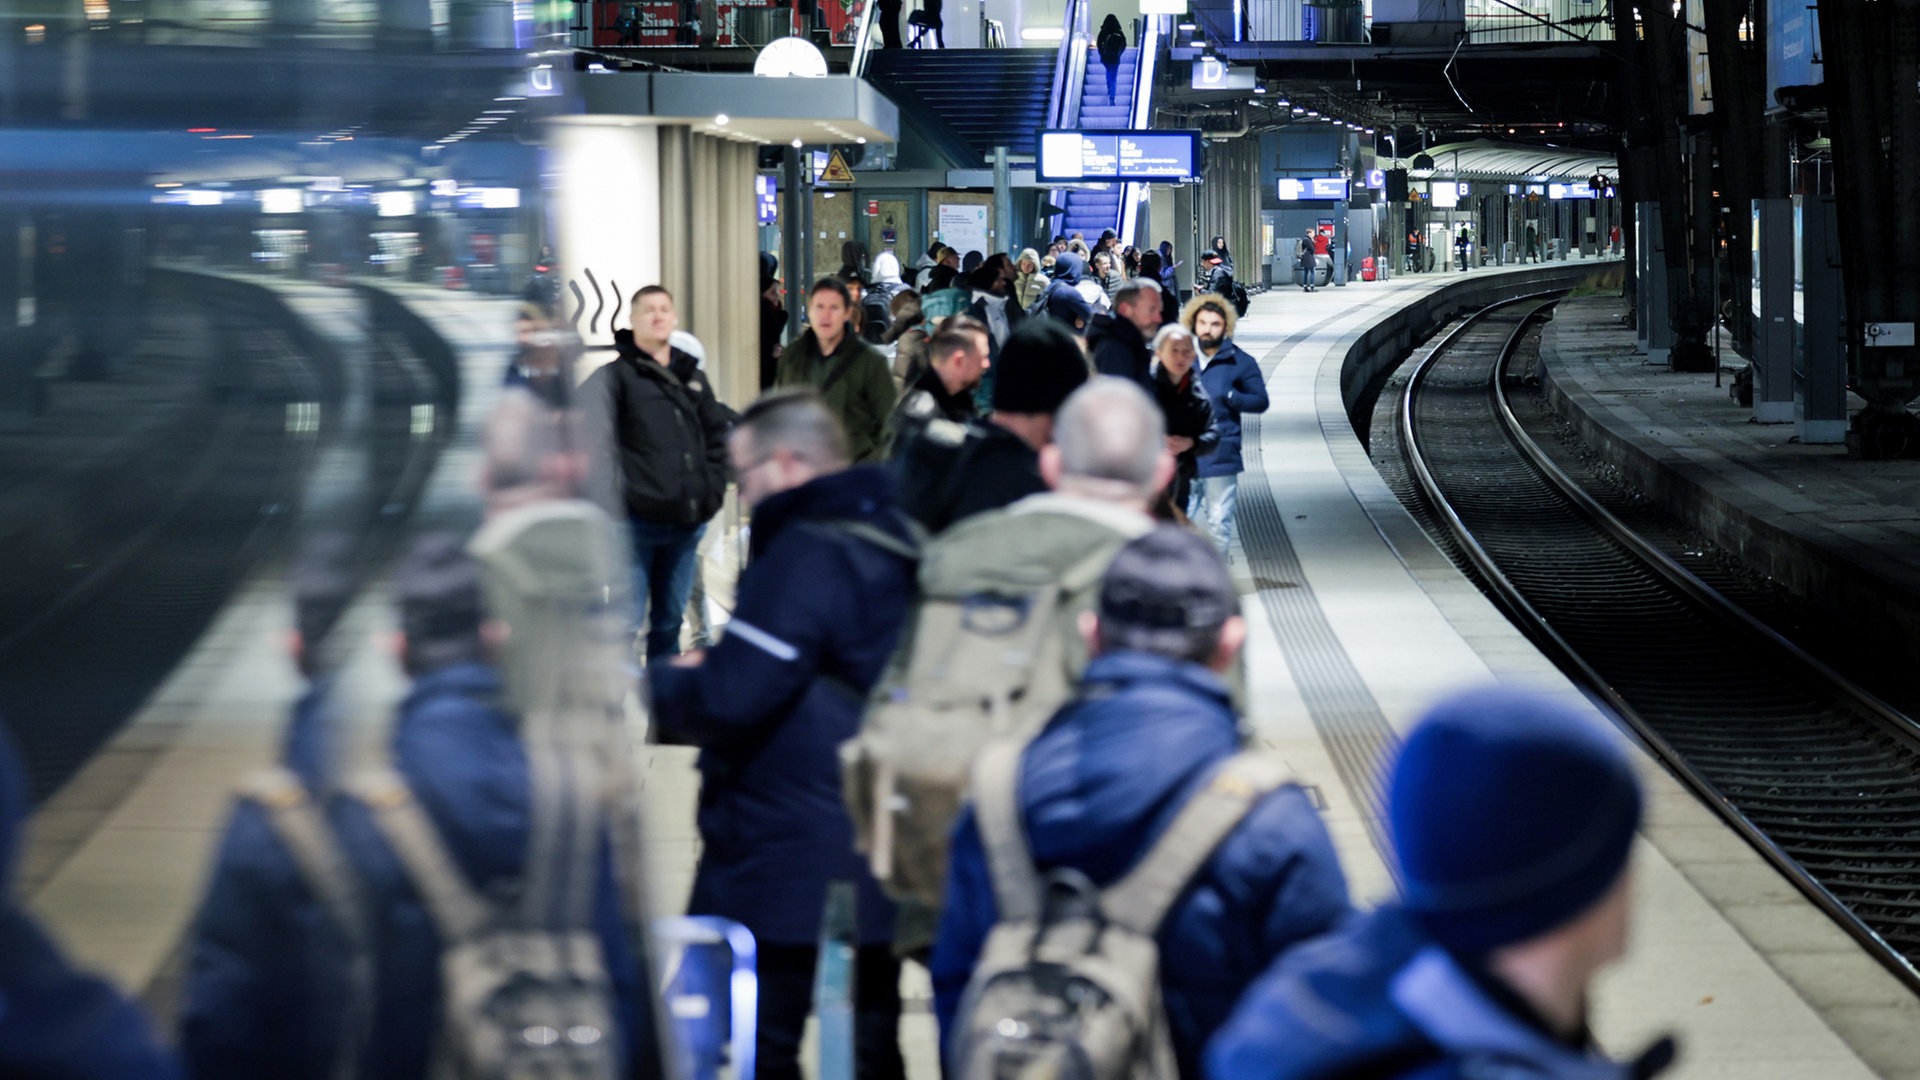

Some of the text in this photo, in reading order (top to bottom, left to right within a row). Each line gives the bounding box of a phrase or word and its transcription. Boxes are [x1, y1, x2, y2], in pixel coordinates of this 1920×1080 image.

[1203, 60, 1222, 83] D
[1371, 170, 1383, 186] C
[1459, 183, 1469, 195] B
[1605, 187, 1614, 198] A
